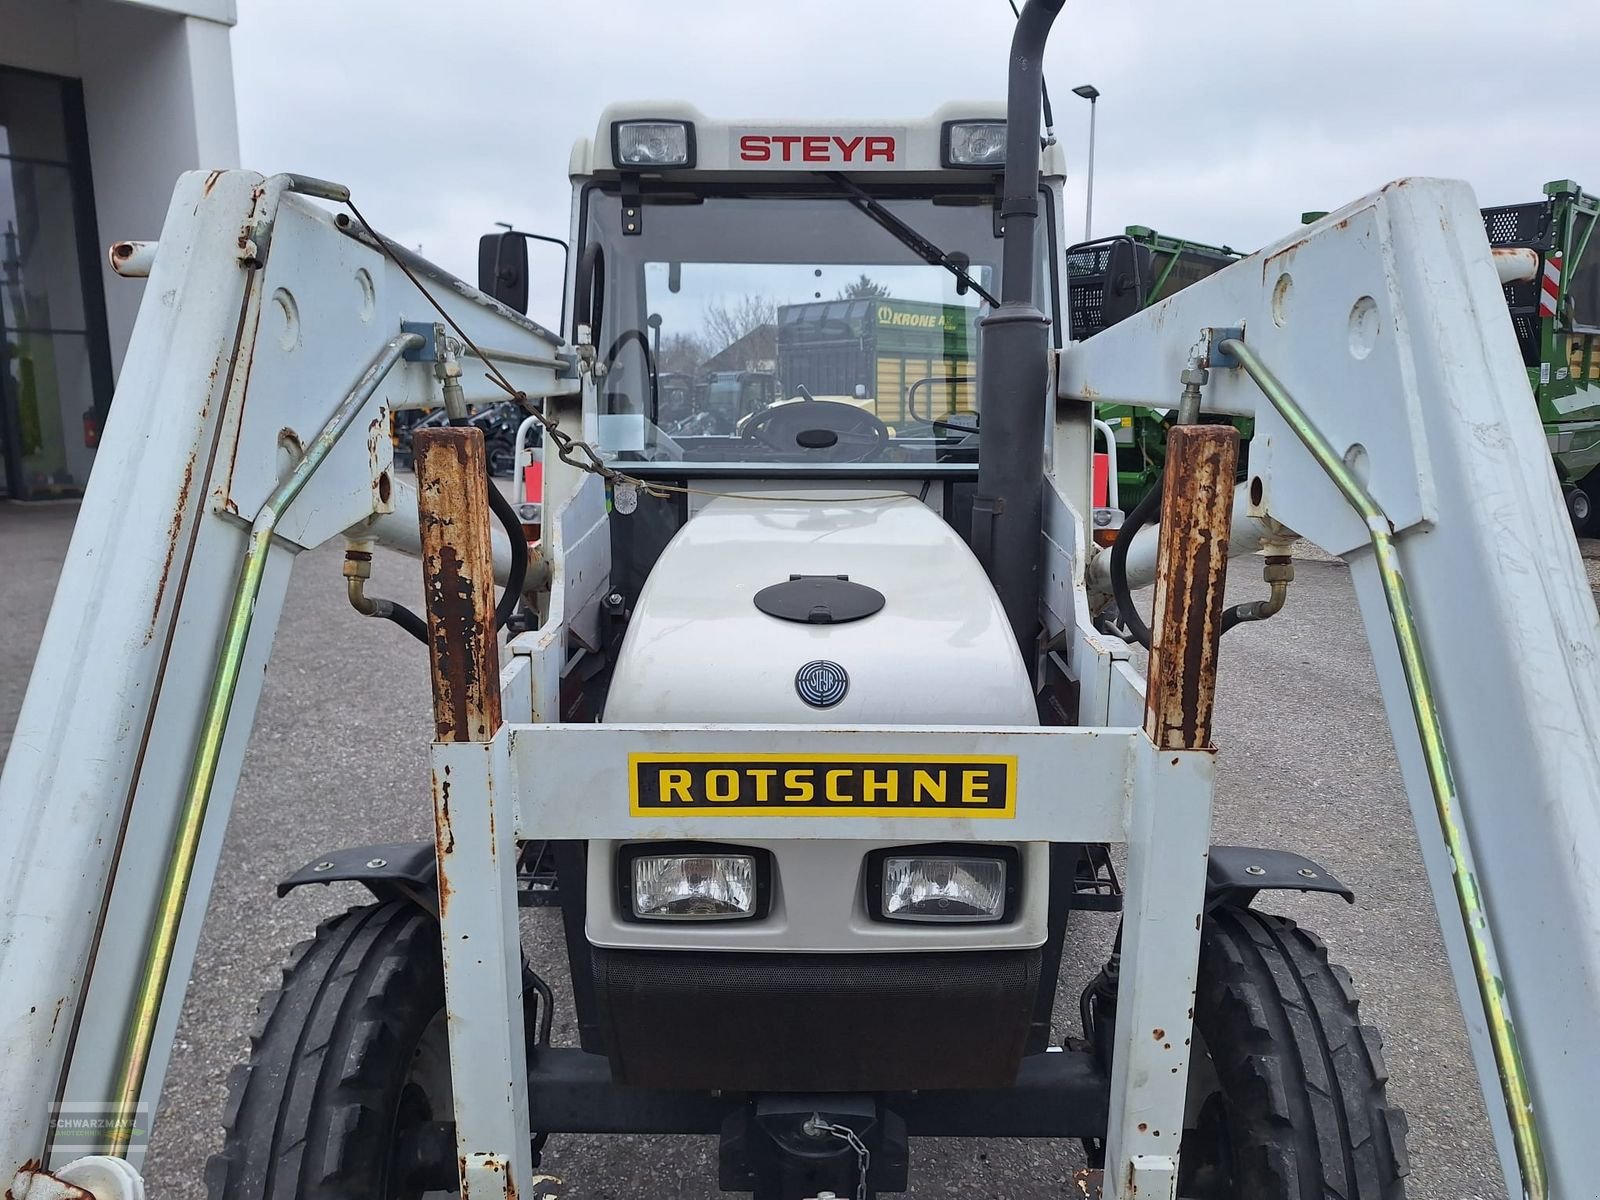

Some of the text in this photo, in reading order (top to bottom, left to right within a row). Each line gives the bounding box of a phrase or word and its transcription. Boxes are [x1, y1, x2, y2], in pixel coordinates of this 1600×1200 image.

[740, 135, 895, 162] STEYR
[892, 311, 937, 328] KRONE
[810, 669, 834, 692] STEYR
[659, 769, 989, 803] ROTSCHNE
